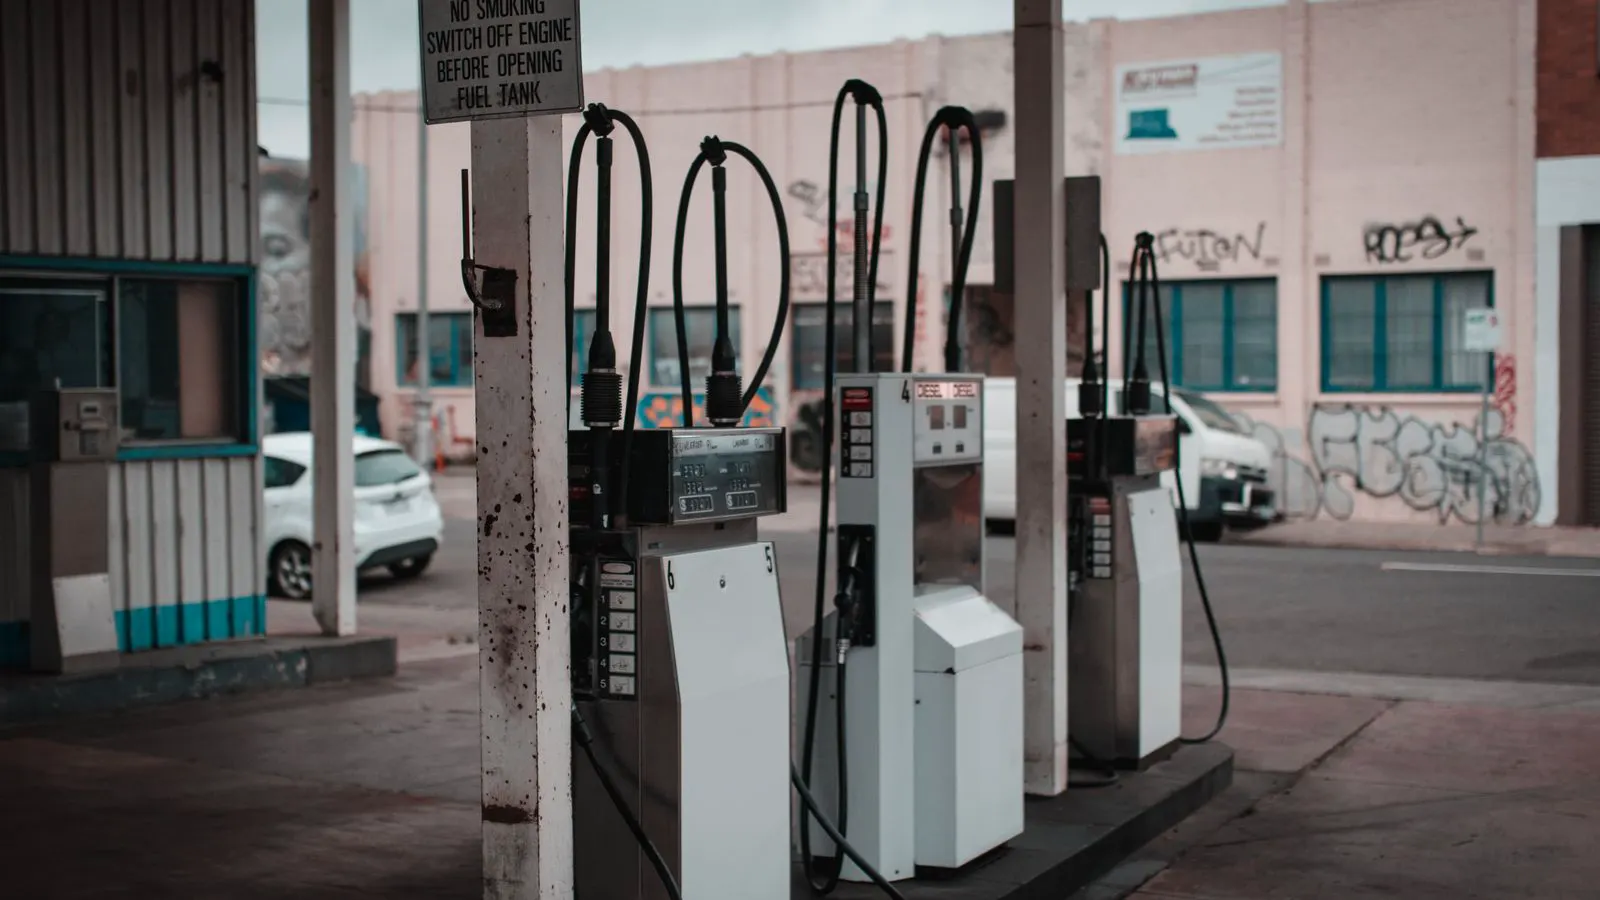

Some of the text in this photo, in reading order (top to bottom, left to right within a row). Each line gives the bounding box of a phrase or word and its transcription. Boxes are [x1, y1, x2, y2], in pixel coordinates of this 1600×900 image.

[451, 0, 545, 22] NO SMOKING
[427, 18, 572, 54] SWITCH OFF ENGINE
[437, 49, 562, 82] BEFORE OPENING
[458, 81, 542, 110] FUEL TANK
[901, 380, 910, 403] 4
[918, 384, 942, 398] DIESEL
[765, 546, 773, 573] 5
[667, 560, 675, 590] 6
[600, 616, 607, 625] 2
[600, 637, 607, 646] 3
[600, 659, 607, 667] 4
[600, 679, 607, 688] 5
